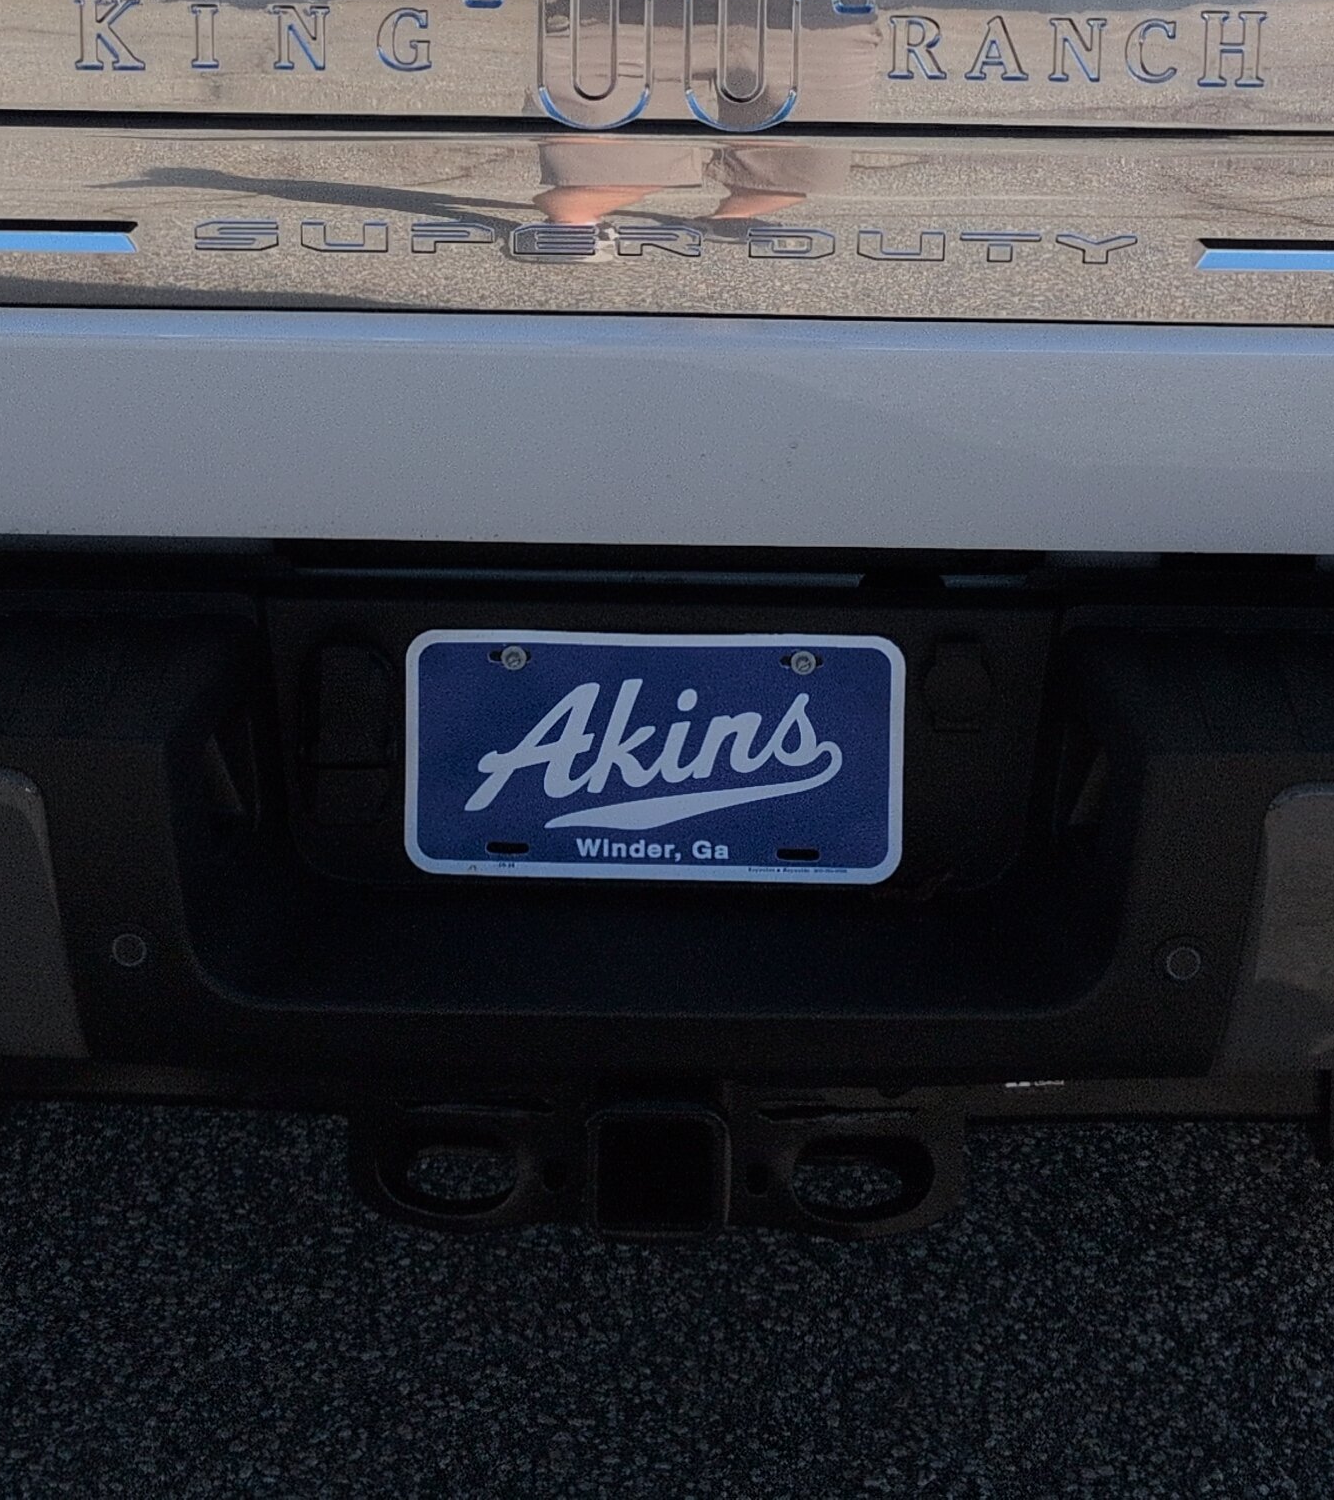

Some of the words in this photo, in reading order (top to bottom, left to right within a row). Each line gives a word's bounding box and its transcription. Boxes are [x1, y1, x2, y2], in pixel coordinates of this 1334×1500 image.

[886, 10, 1268, 89] RANCH
[194, 219, 703, 259] SUPER
[748, 226, 1138, 265] DUTY
[464, 678, 843, 831] Akins
[576, 838, 682, 862] Winder,
[691, 840, 729, 861] Ga
